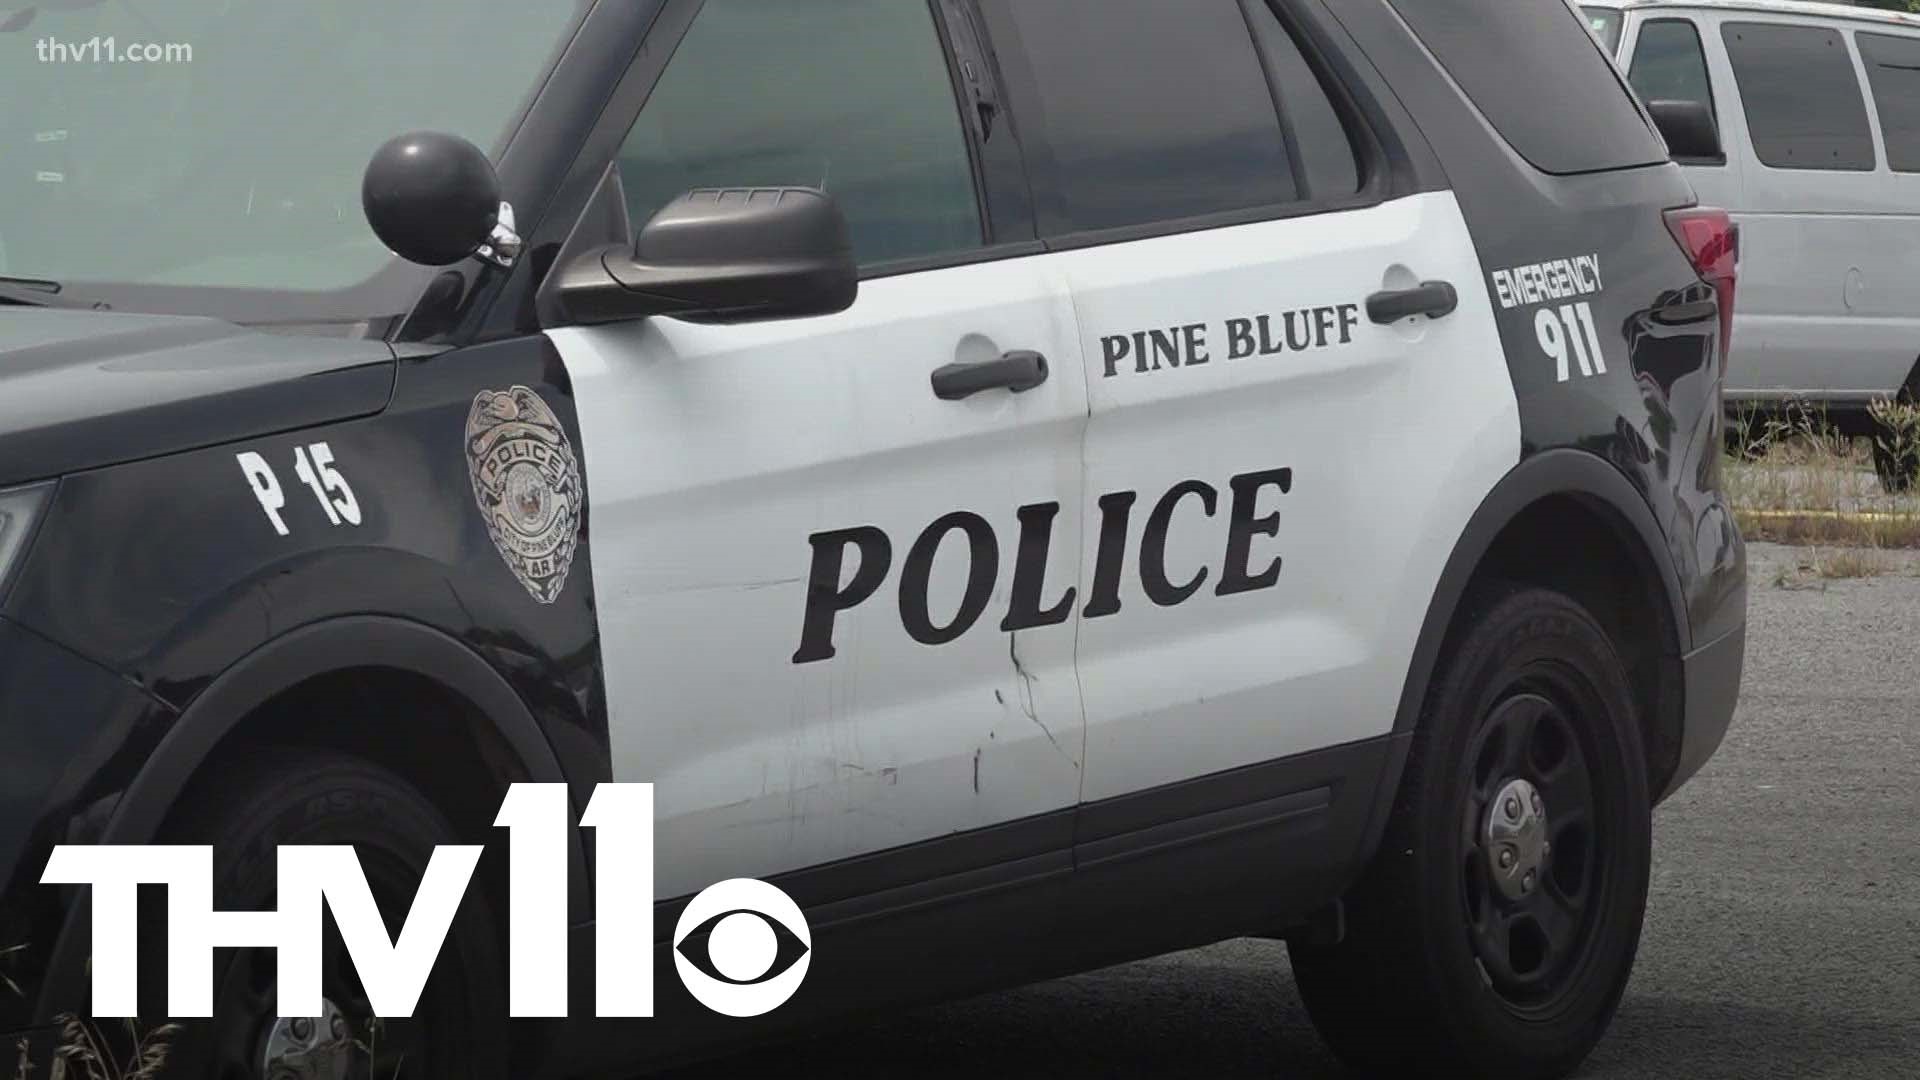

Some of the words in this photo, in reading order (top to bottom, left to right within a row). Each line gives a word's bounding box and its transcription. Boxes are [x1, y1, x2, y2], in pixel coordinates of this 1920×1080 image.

[1492, 253, 1603, 309] EMERGENCY
[1100, 322, 1210, 378] PINE
[1225, 303, 1359, 360] BLUFF
[1534, 302, 1607, 383] 911
[236, 451, 290, 536] P
[294, 441, 362, 526] 15
[487, 443, 563, 479] POLICE
[532, 559, 551, 577] AR
[792, 466, 1293, 664] POLICE
